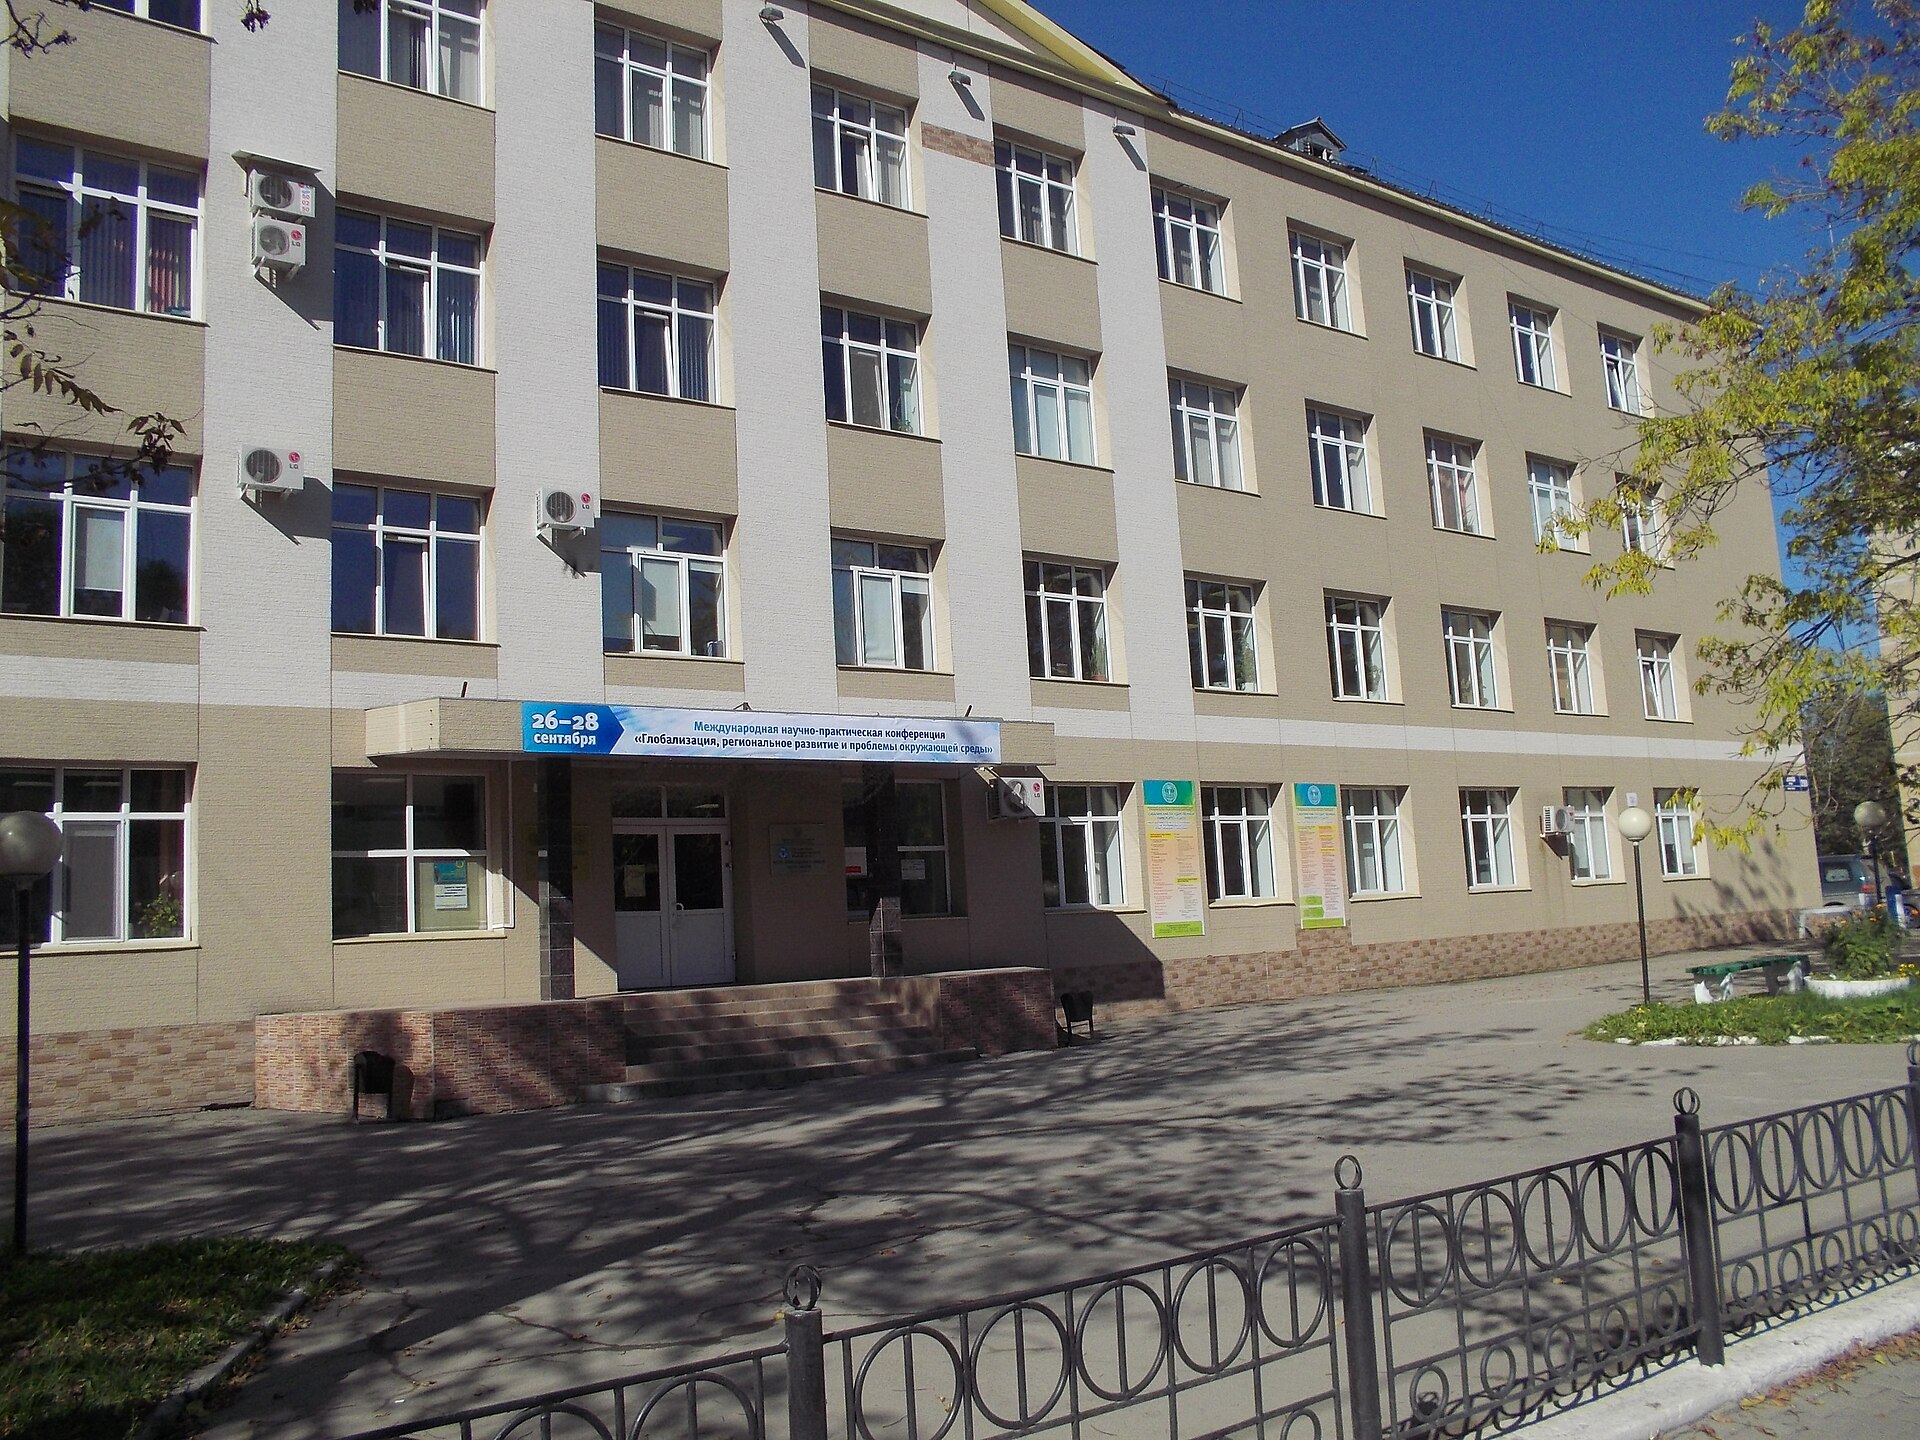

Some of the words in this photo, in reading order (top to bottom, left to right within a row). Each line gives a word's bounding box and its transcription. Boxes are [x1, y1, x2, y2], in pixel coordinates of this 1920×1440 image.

[533, 732, 596, 748] сентября
[694, 721, 779, 735] Международная
[781, 725, 883, 739] научно-практическая
[885, 728, 946, 741] конференция
[634, 734, 720, 748] «Глобализация,
[722, 738, 792, 749] региональное
[794, 740, 839, 751] развитие
[849, 741, 898, 752] проблемы
[899, 743, 959, 754] окружающей
[960, 745, 993, 754] среды»
